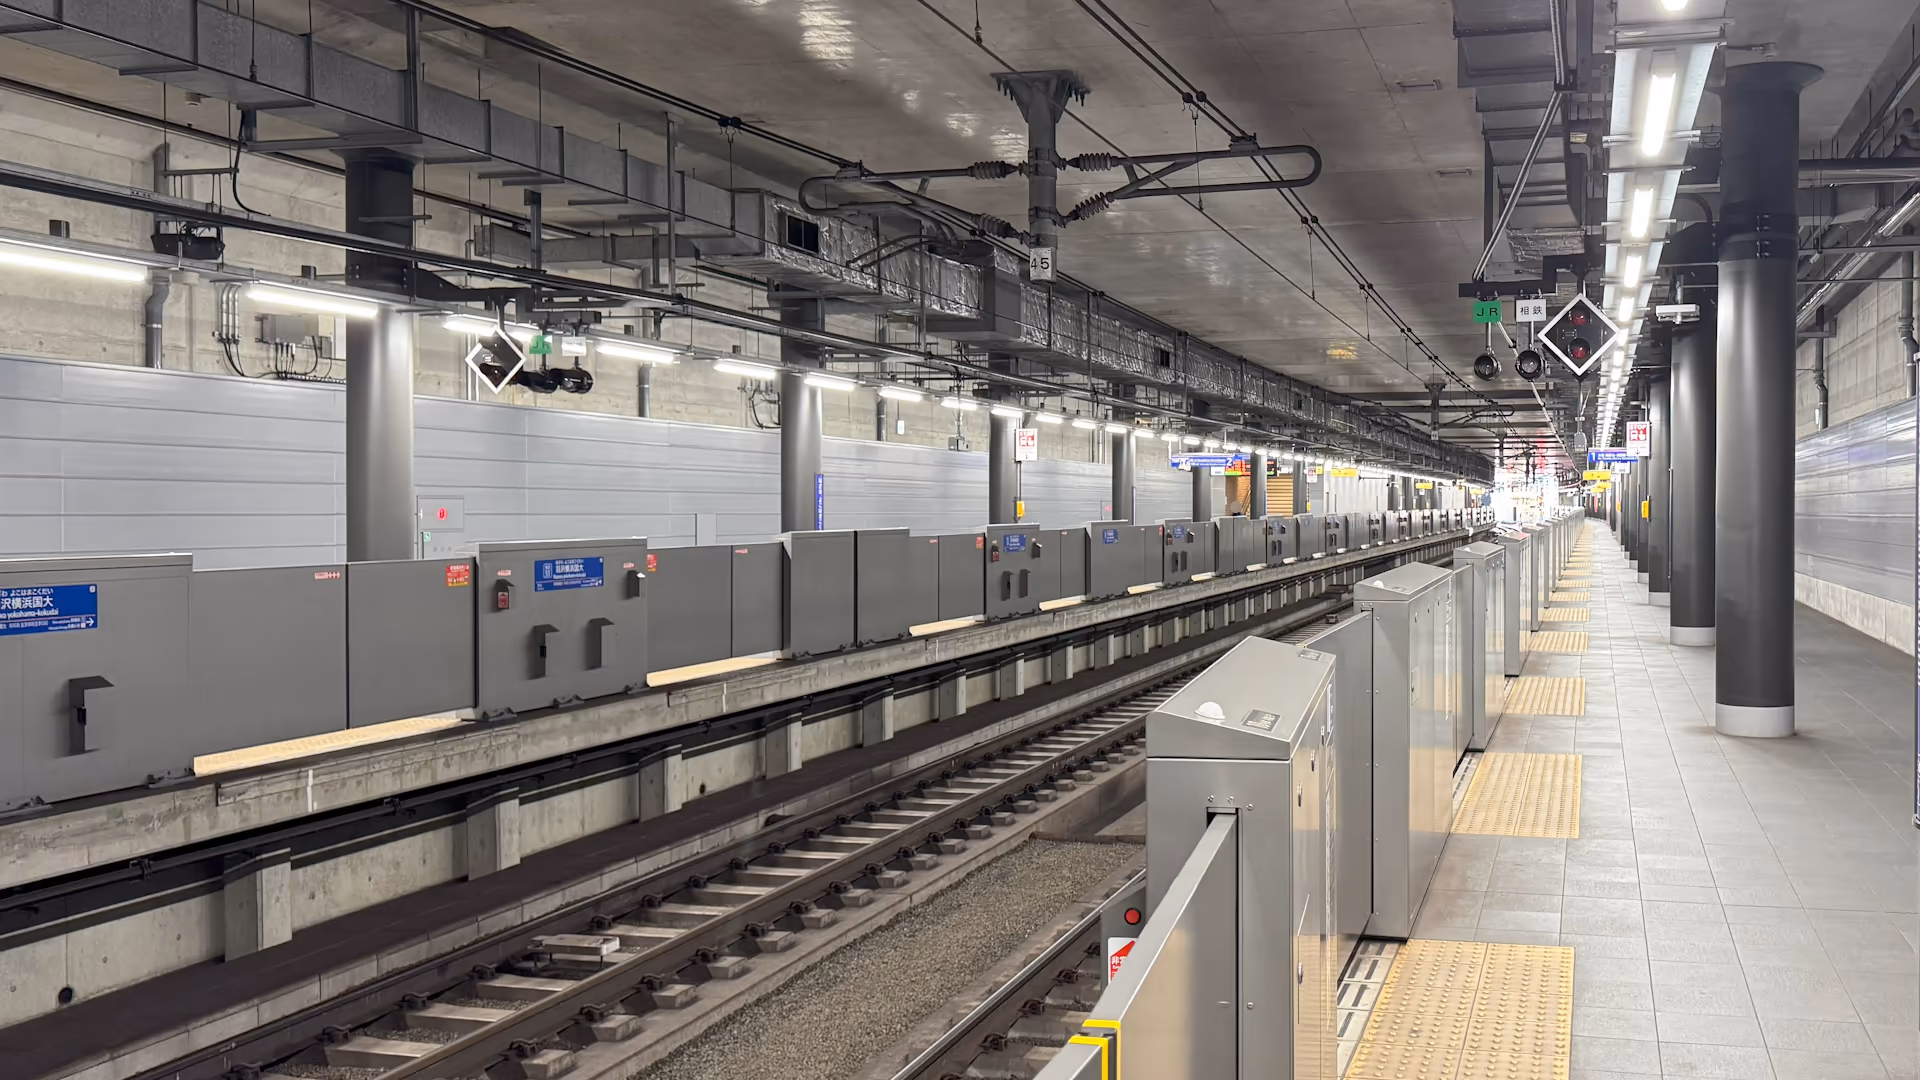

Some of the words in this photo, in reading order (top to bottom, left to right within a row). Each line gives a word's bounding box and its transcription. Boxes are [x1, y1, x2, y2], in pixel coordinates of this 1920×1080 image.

[1030, 257, 1050, 270] 45
[1476, 307, 1499, 317] JR
[1519, 305, 1543, 316] 相鉄
[1226, 458, 1233, 466] 2
[0, 595, 54, 610] 沢横浜国大
